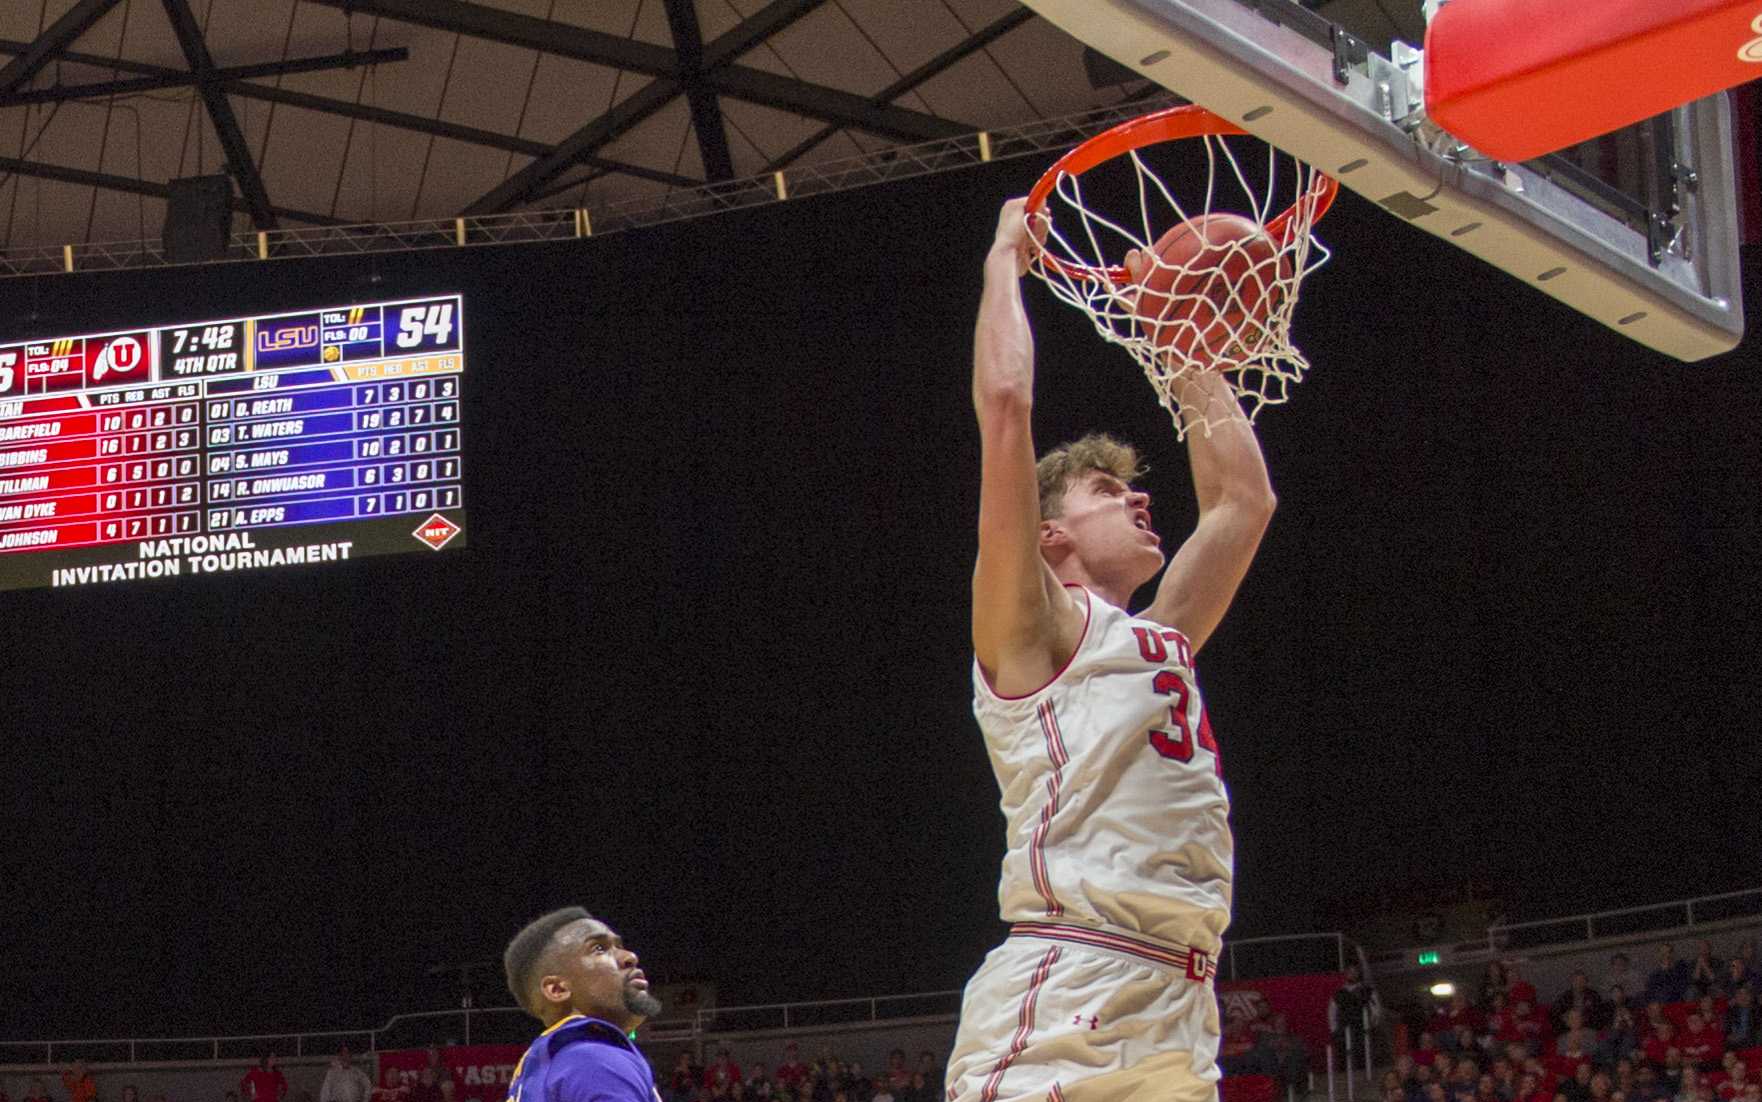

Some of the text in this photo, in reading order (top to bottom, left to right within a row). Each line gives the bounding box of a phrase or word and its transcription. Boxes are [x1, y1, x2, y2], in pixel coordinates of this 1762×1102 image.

[349, 327, 368, 341] 00
[396, 303, 453, 348] 54
[172, 326, 235, 354] 7:42
[258, 326, 319, 352] LSU
[113, 343, 135, 367] U
[174, 352, 237, 375] 4TH QTR
[100, 385, 196, 405] PTS REB AST FLS
[253, 375, 279, 390] LSU
[210, 403, 229, 418] 01
[253, 398, 293, 414] REATH
[364, 390, 374, 403] 7
[389, 387, 400, 401] 3
[442, 382, 453, 396] 3
[104, 416, 122, 431] 10
[132, 414, 143, 428] 0
[154, 412, 165, 426] 2
[182, 408, 192, 422] 0
[211, 406, 453, 443] 03 T. WATERS 19 2 7 4
[102, 439, 118, 454] 16
[132, 437, 140, 451] 1
[156, 435, 167, 449] 2
[179, 433, 190, 447] 3
[211, 435, 451, 472] 04 S. MAYS 10 2 0 1
[107, 468, 117, 482] 6
[180, 460, 191, 475] 0
[213, 483, 230, 498] 14
[236, 481, 250, 496] R.
[253, 475, 325, 494] ONWUASOR
[392, 467, 403, 481] 3
[445, 462, 452, 476] 1
[24, 502, 57, 519] DYKE
[106, 494, 117, 509] 0
[134, 493, 141, 506] 1
[158, 490, 166, 504] 1
[181, 487, 192, 501] 2
[211, 512, 228, 527] 21
[251, 507, 285, 523] EPPS
[366, 498, 376, 513] 7
[396, 495, 402, 510] 1
[445, 491, 452, 505] 1
[0, 516, 190, 549] JOHNSON 4 7 1 1
[425, 526, 449, 537] NIT
[139, 532, 255, 558] NATIONAL
[52, 542, 352, 587] INVITATION TOURNAMENT
